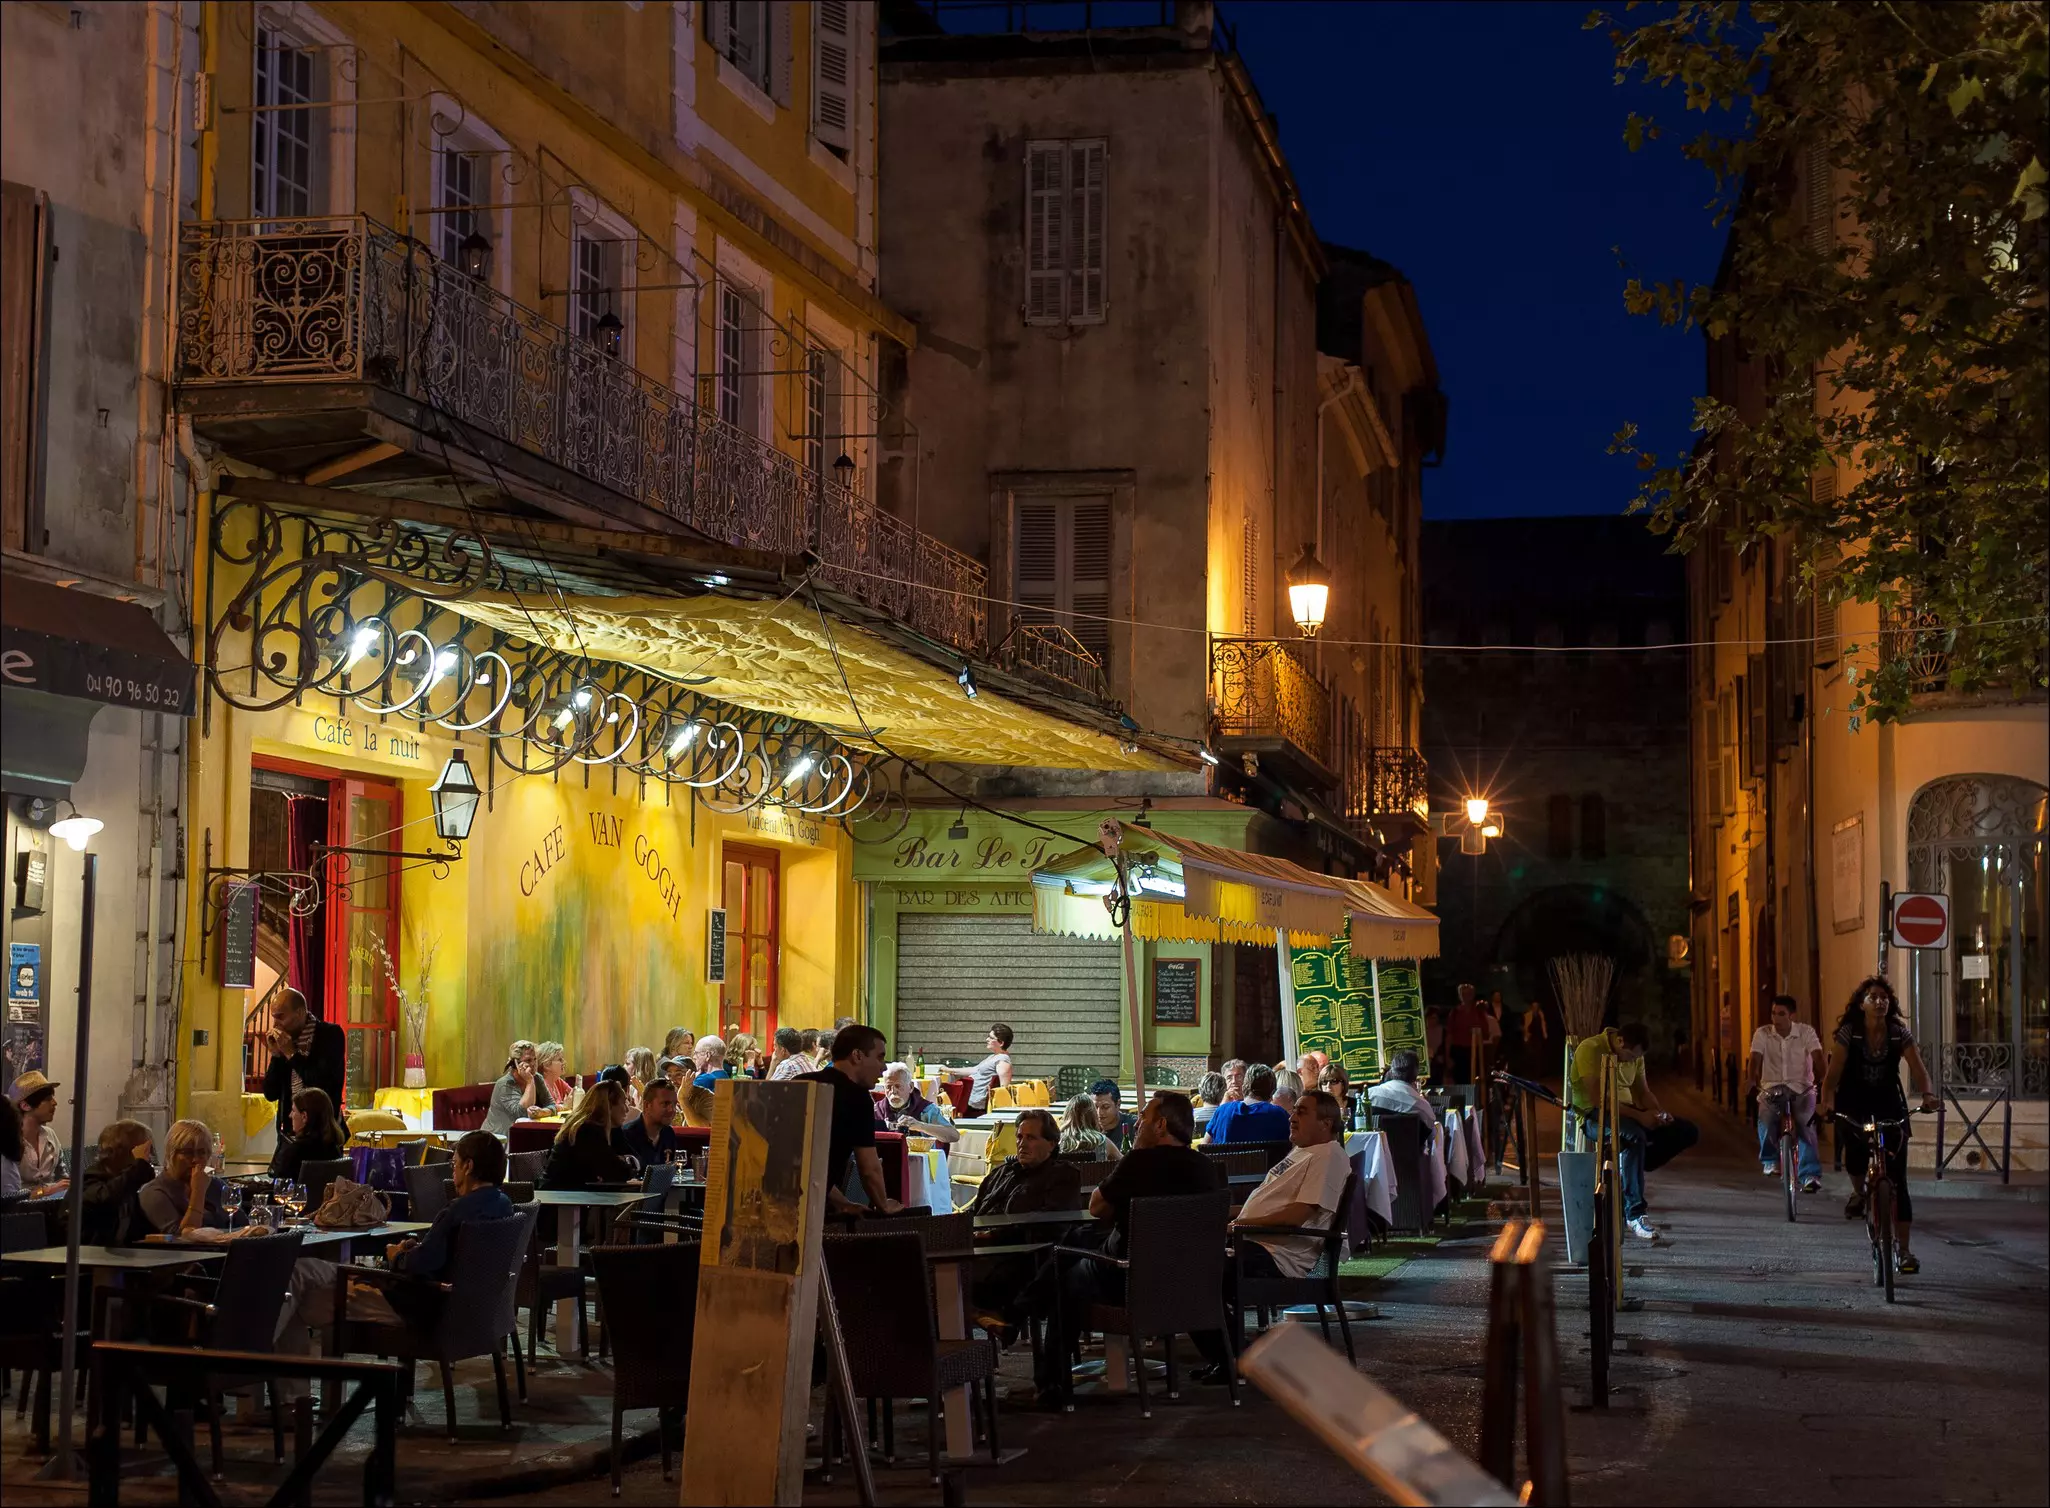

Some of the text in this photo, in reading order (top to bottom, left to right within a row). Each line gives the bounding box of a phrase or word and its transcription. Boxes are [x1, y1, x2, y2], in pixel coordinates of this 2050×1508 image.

[87, 673, 179, 707] 04 90 96 50 22
[314, 716, 420, 760] Café la nuit
[745, 809, 820, 846] Vincent Van Gogh
[520, 812, 682, 922] CAFÉ VAN GOGH
[893, 836, 962, 869] Bar
[971, 836, 1013, 870] Le
[897, 890, 1032, 906] BAR DES AFIC
